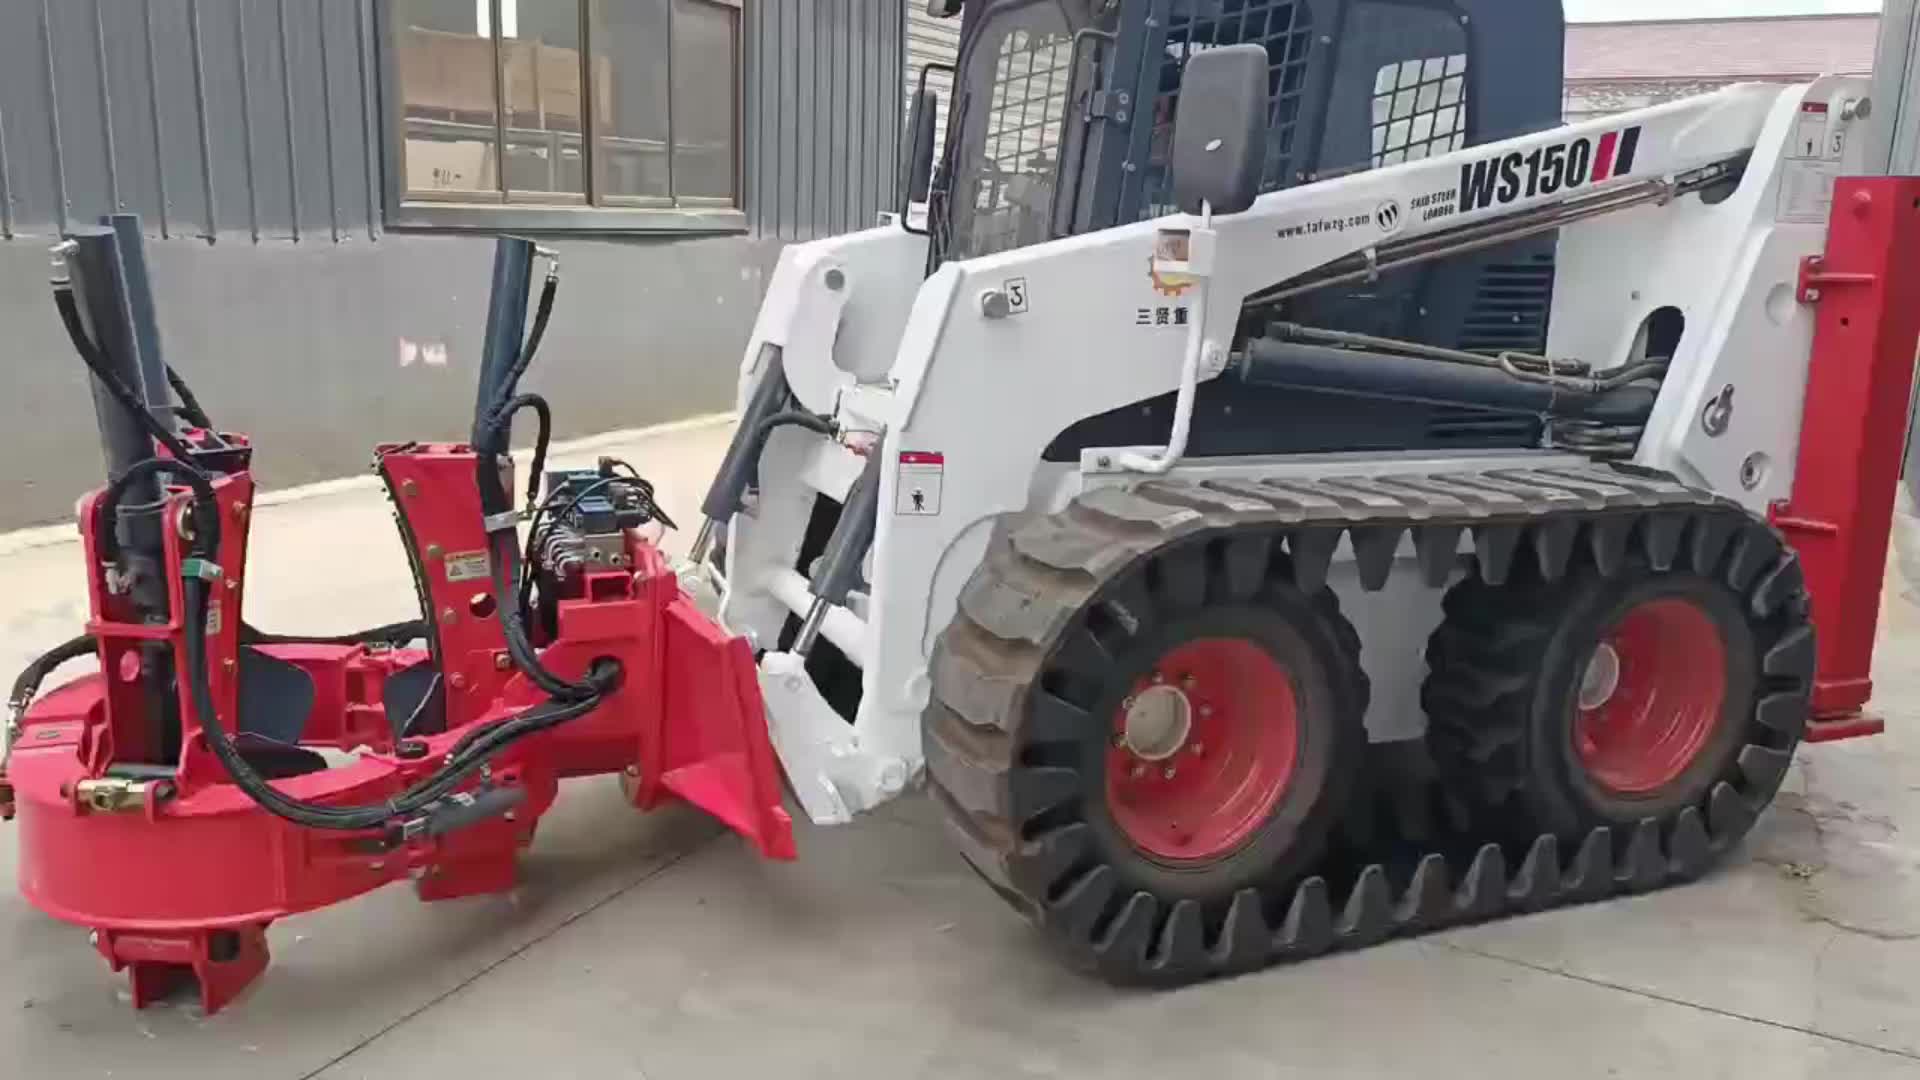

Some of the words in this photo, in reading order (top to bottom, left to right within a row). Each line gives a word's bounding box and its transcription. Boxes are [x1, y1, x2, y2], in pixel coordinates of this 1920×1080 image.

[1431, 188, 1456, 204] STEER
[1423, 204, 1455, 222] LOADER
[1010, 285, 1023, 307] 3
